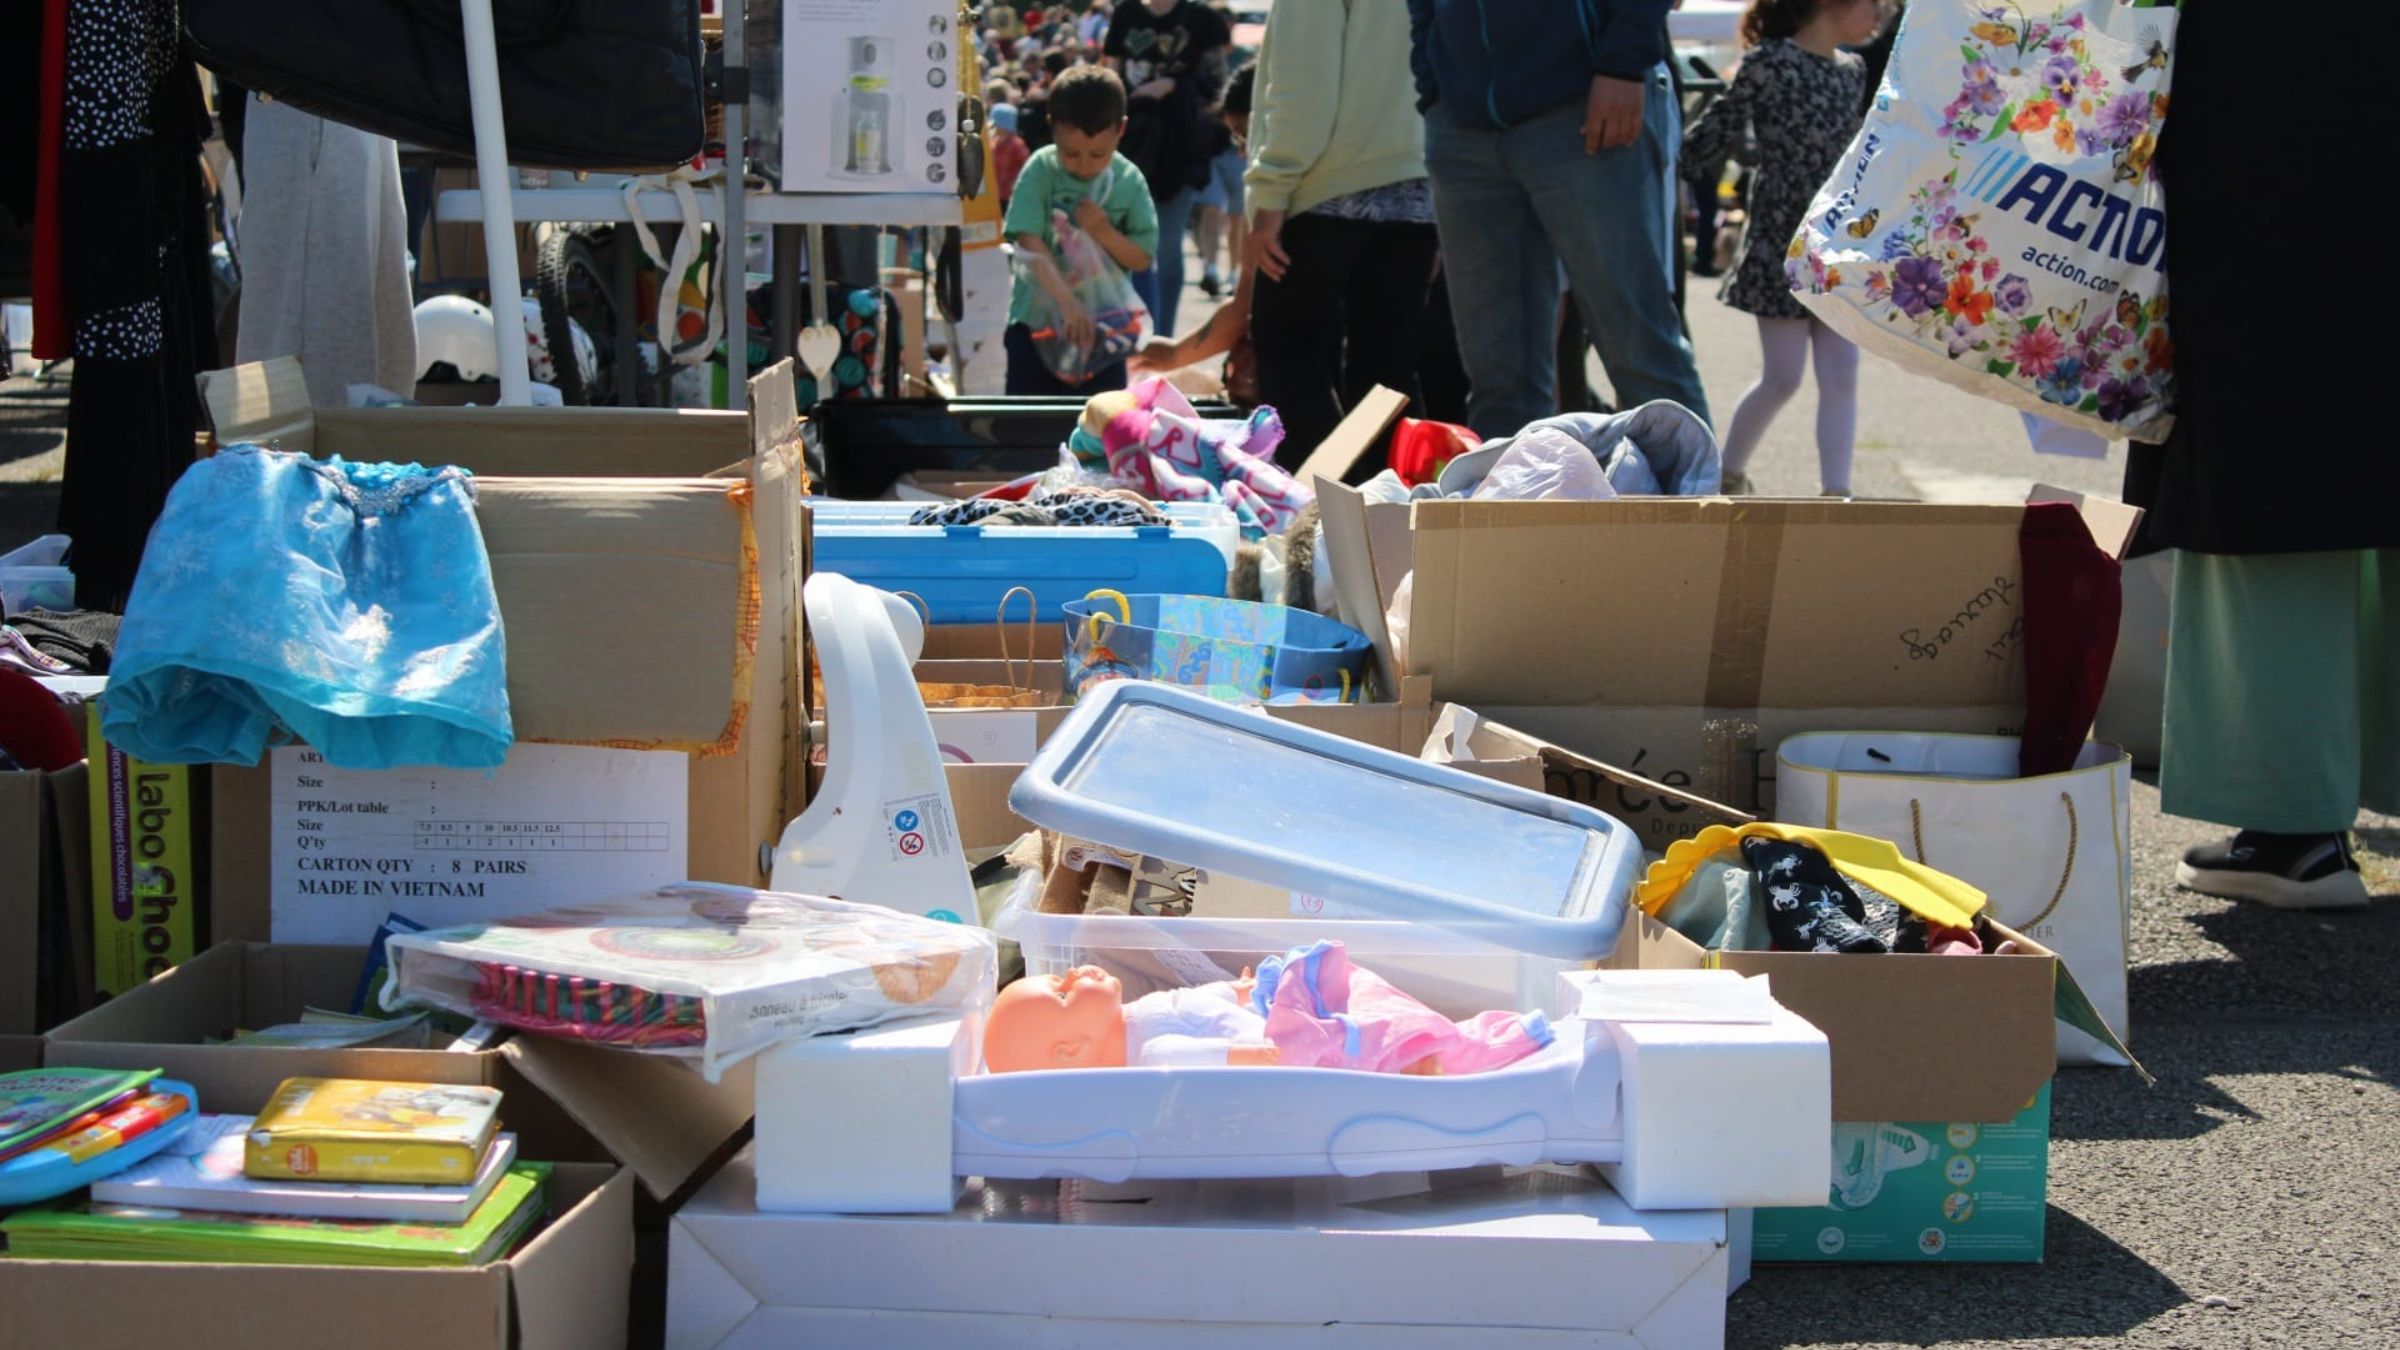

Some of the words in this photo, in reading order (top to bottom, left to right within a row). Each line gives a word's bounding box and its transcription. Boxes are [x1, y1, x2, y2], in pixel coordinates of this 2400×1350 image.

[2021, 246, 2119, 294] action.com
[297, 776, 324, 788] Size
[297, 800, 354, 813] PPK/Lot
[357, 802, 389, 814] table
[297, 818, 324, 831] Size
[502, 824, 518, 832] 10.5
[544, 825, 561, 833] 12.5
[297, 836, 327, 851] Q'ty
[298, 856, 372, 872] CARTON
[376, 859, 414, 875] QTY
[452, 860, 461, 873] 8
[474, 860, 527, 874] PAIRS
[298, 879, 357, 895] MADE
[363, 880, 383, 895] IN
[390, 880, 485, 897] VIETNAM
